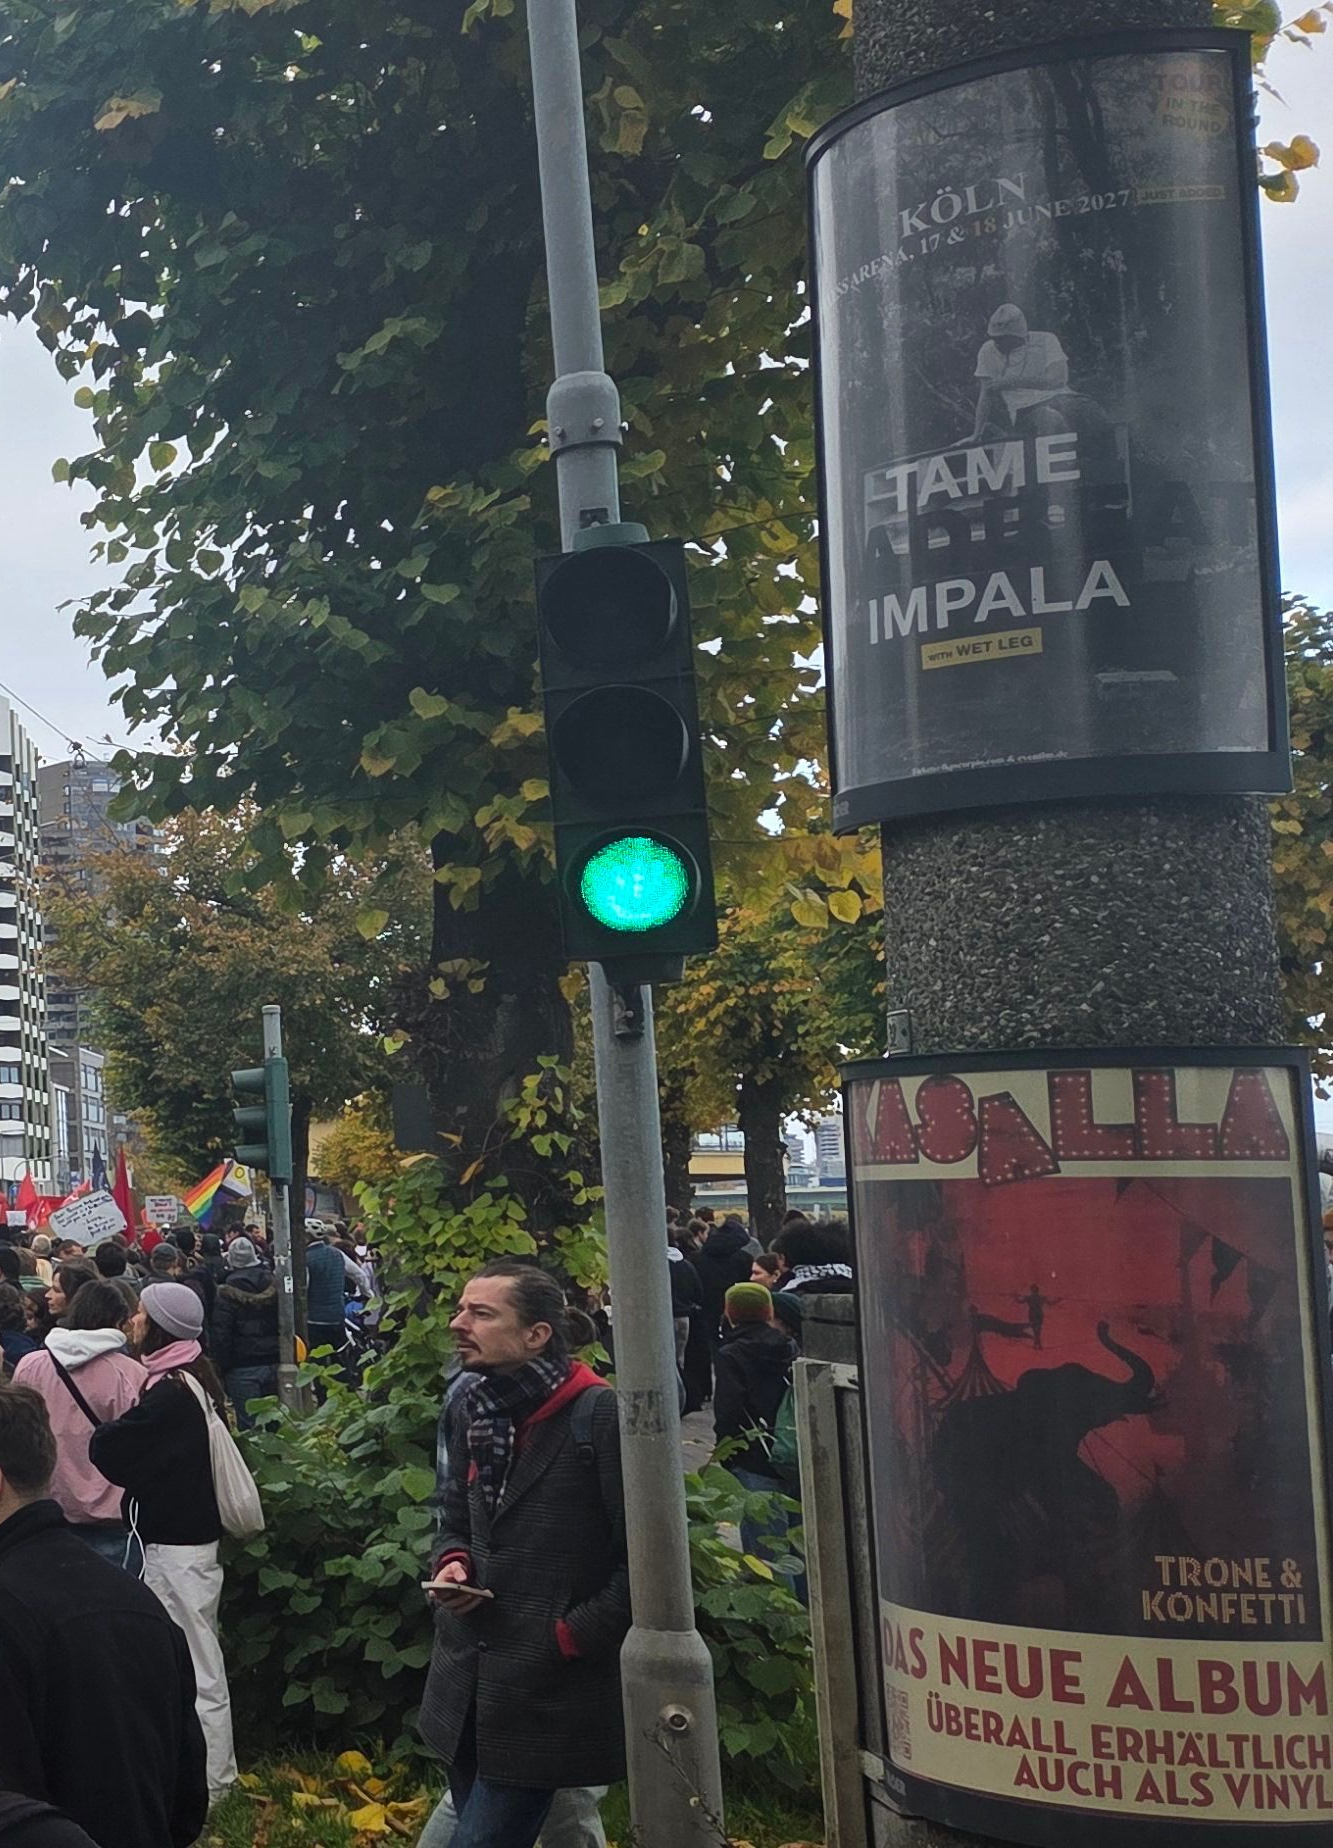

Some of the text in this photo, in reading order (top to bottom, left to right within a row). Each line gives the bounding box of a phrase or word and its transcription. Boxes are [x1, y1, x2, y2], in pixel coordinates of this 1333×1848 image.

[1162, 114, 1222, 133] ROUND
[898, 172, 1029, 238] KÖLN
[920, 233, 940, 255] 17
[947, 225, 965, 245] &
[973, 216, 997, 238] 18
[1003, 200, 1070, 230] JUNE
[1079, 189, 1130, 215] 2027
[1141, 185, 1221, 201] JUST ADDED
[886, 432, 1081, 512] TAME
[869, 560, 1130, 645] IMPALA
[956, 641, 994, 657] WET
[999, 635, 1033, 650] LEG
[1155, 1555, 1302, 1589] TRONE &
[1142, 1590, 1306, 1624] KONFETTI
[882, 1617, 1329, 1717] DAS NEUE ALBUM
[926, 1690, 1333, 1771] ÜBERALL ERHÄLTLICH
[1014, 1754, 1333, 1810] AUCH ALS VINYL
